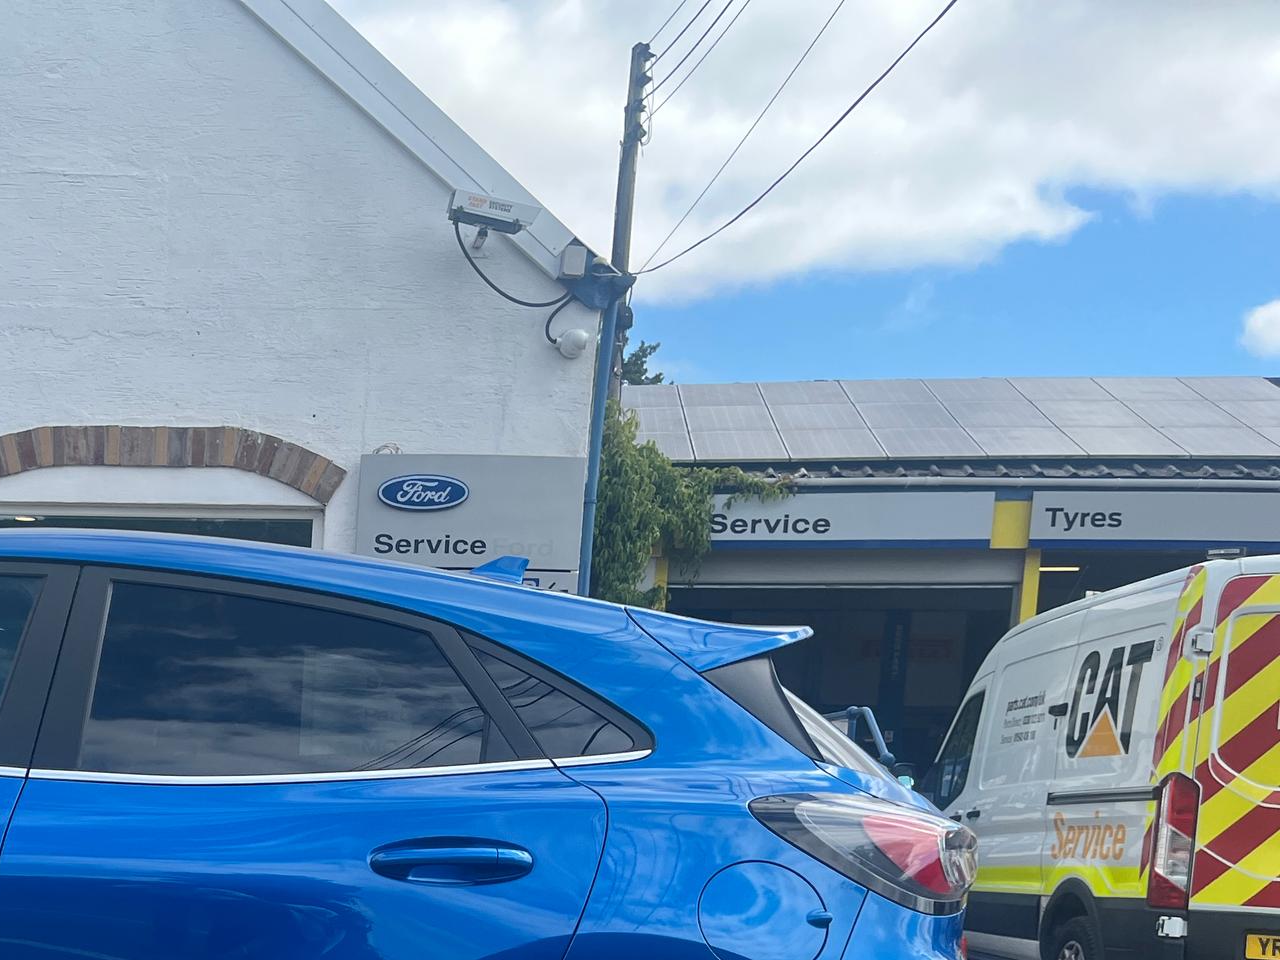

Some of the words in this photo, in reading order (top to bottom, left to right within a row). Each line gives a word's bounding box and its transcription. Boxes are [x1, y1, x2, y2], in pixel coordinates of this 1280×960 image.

[396, 479, 451, 503] Ford
[710, 513, 831, 534] Service
[1045, 507, 1123, 532] Tyres
[374, 533, 487, 555] Service
[1066, 639, 1156, 758] CAT
[1051, 811, 1126, 860] Service
